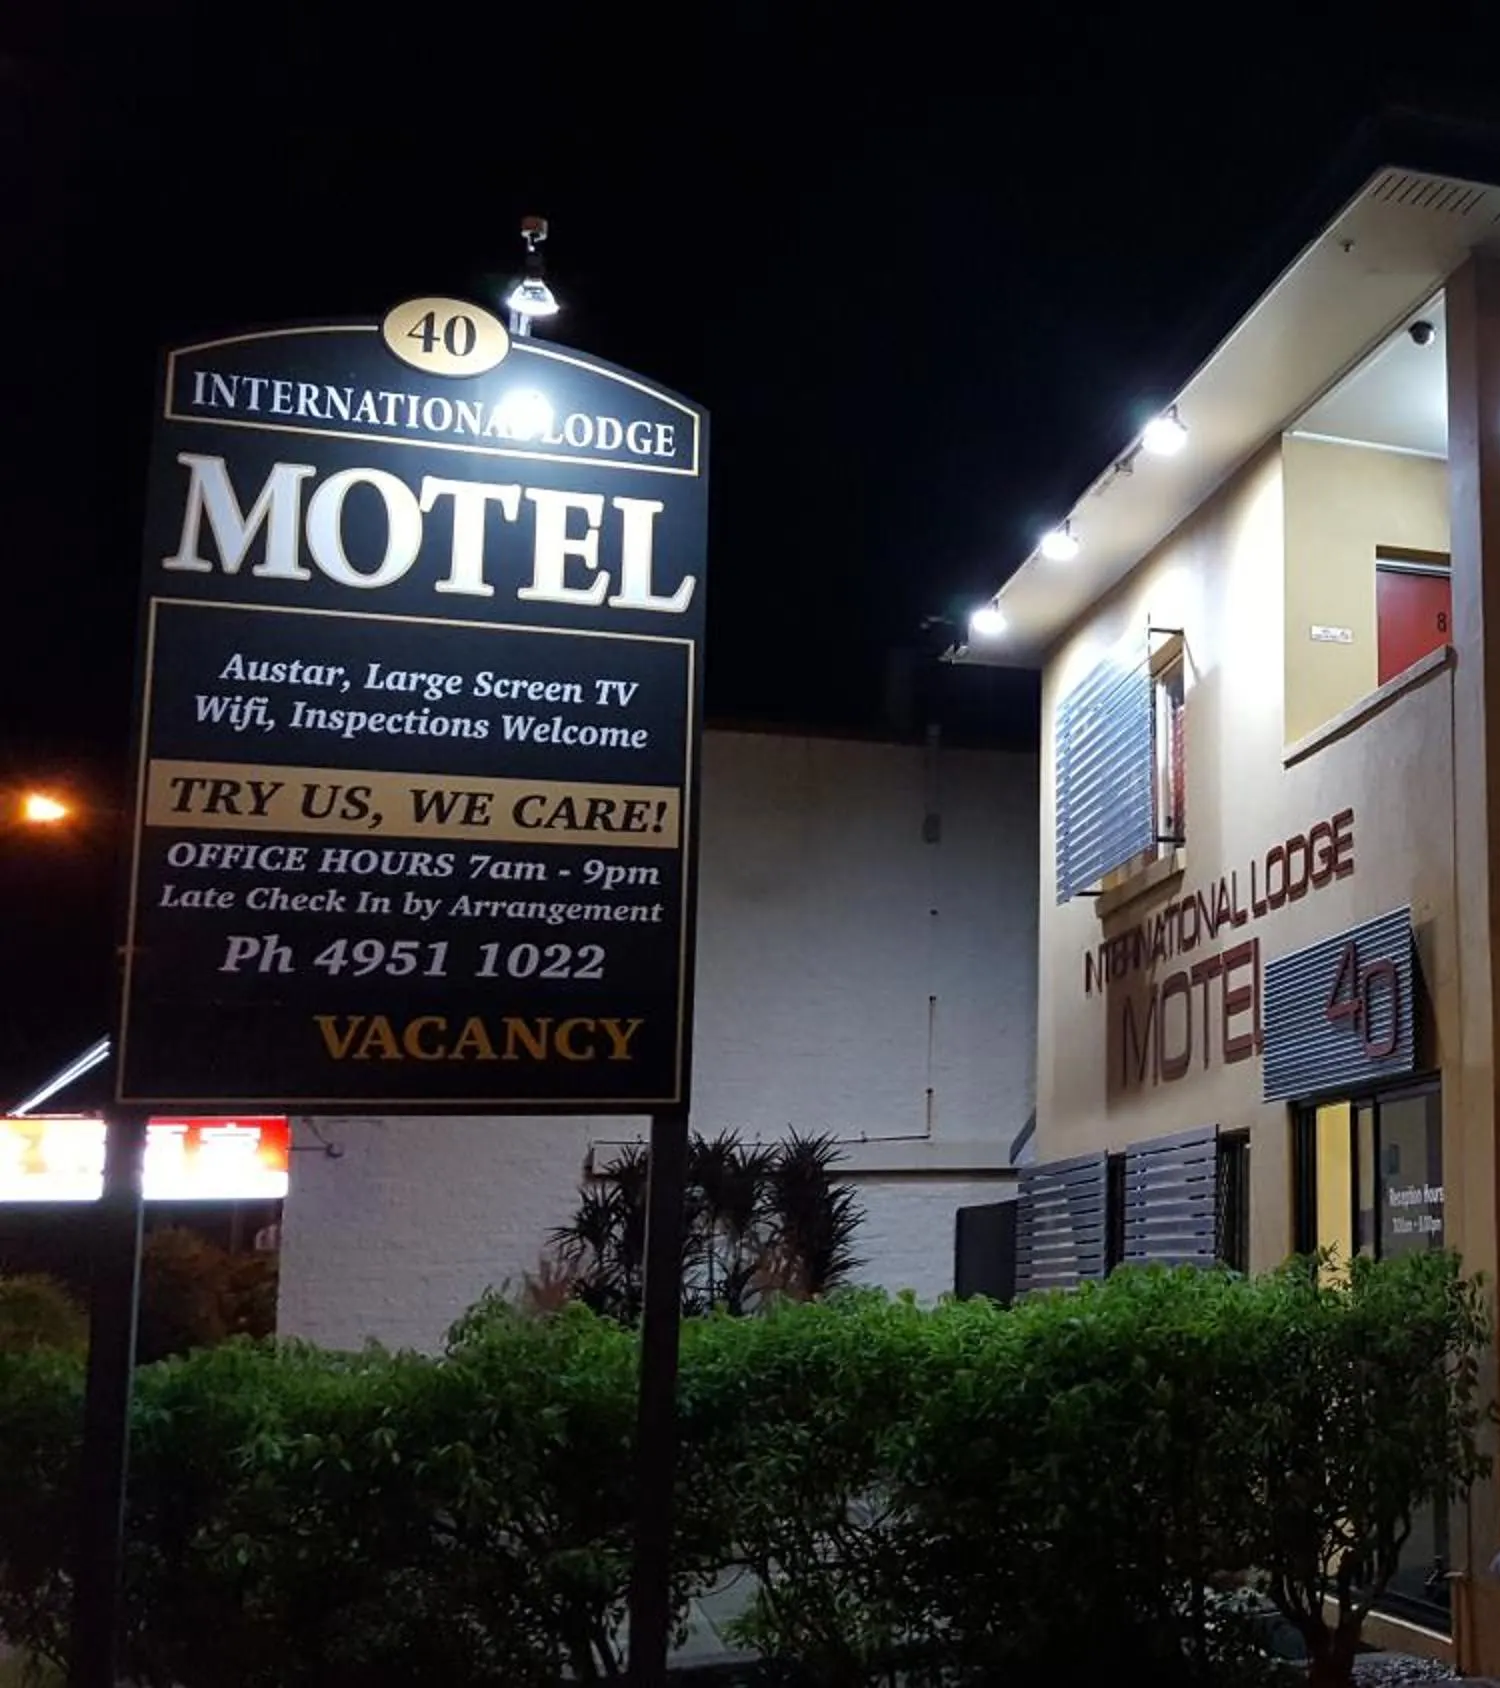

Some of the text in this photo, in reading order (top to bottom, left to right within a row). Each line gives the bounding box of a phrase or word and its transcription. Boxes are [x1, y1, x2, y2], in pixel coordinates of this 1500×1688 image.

[405, 312, 477, 358] 40
[192, 371, 677, 457] INTERNATIONA LODGE
[161, 452, 696, 614] MOTEL
[1437, 612, 1447, 632] 8
[219, 653, 639, 707] Austar, Large Screen TV
[195, 695, 649, 749] Wifi, Inspections Welcome
[170, 777, 668, 833] TRY US, WE CARE!
[167, 841, 308, 871] OFFICE
[318, 847, 455, 879] HOURS
[468, 854, 548, 882] 7am
[582, 859, 661, 890] 9pm
[1251, 808, 1355, 919] LODGE
[160, 884, 664, 925] Late Check In by Arrangement
[219, 935, 606, 980] Ph 4951 1022
[1122, 937, 1263, 1088] MOTEL
[1326, 940, 1399, 1059] 40
[313, 1014, 643, 1061] VACANCY
